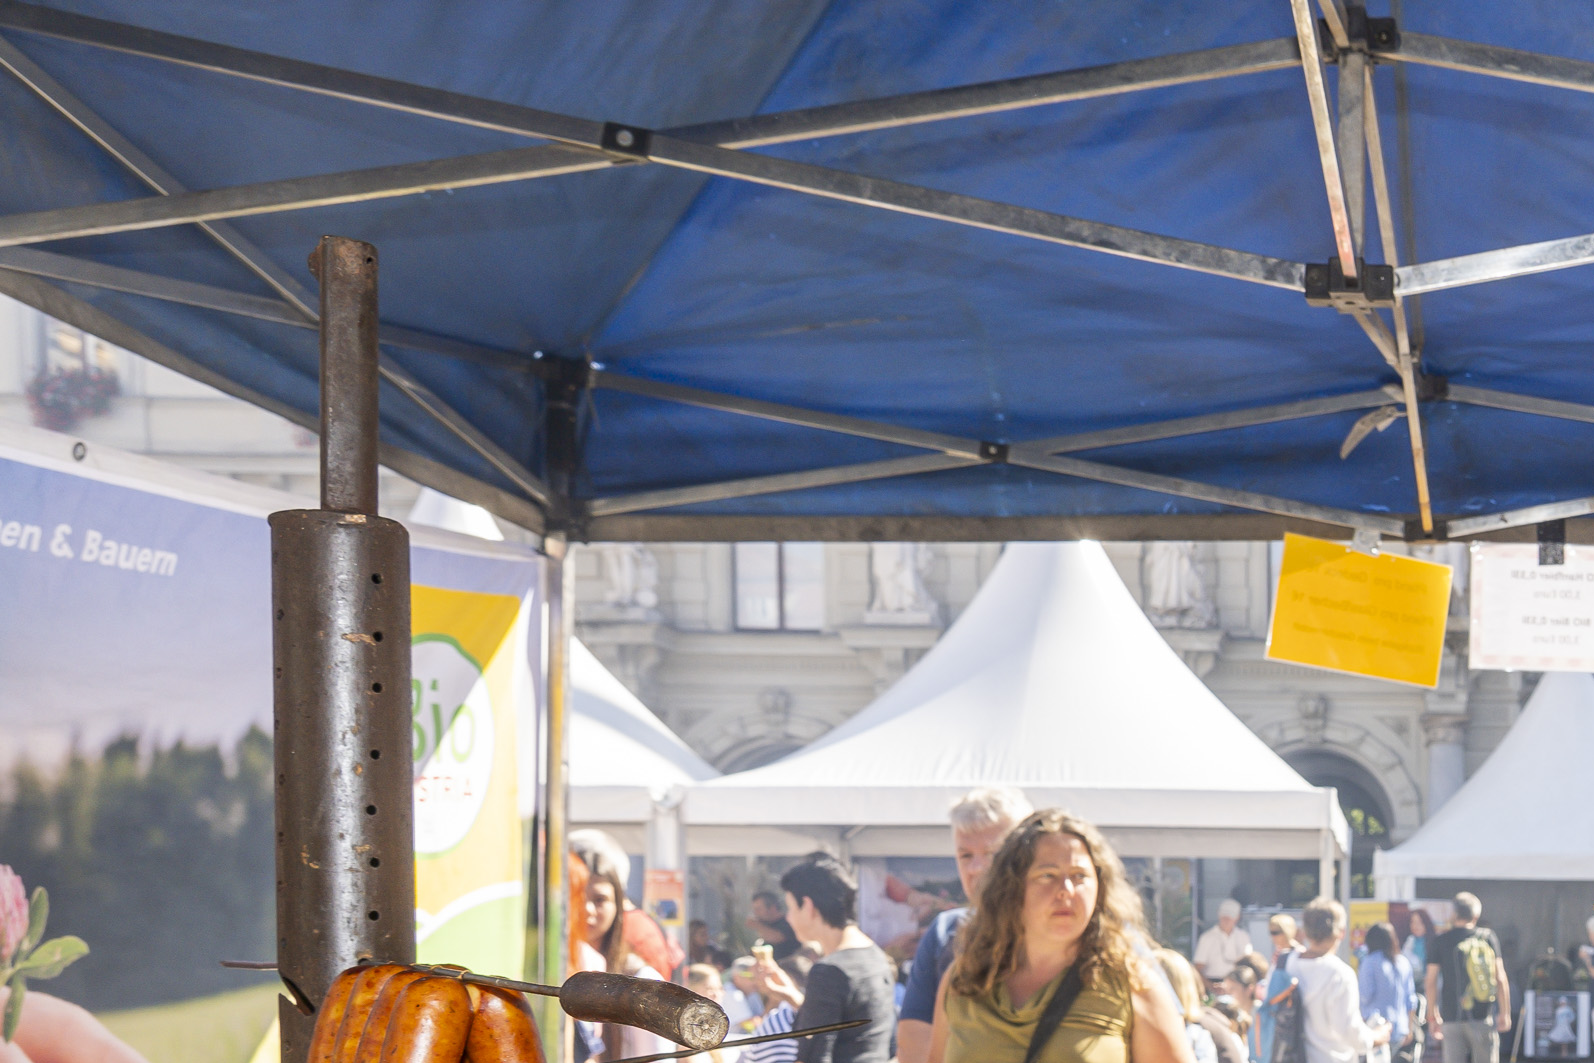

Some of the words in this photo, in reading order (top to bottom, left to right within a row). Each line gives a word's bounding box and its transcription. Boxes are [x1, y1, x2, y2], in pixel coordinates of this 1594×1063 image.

[0, 518, 43, 552] en
[49, 522, 75, 560] &
[80, 528, 179, 577] Bauern
